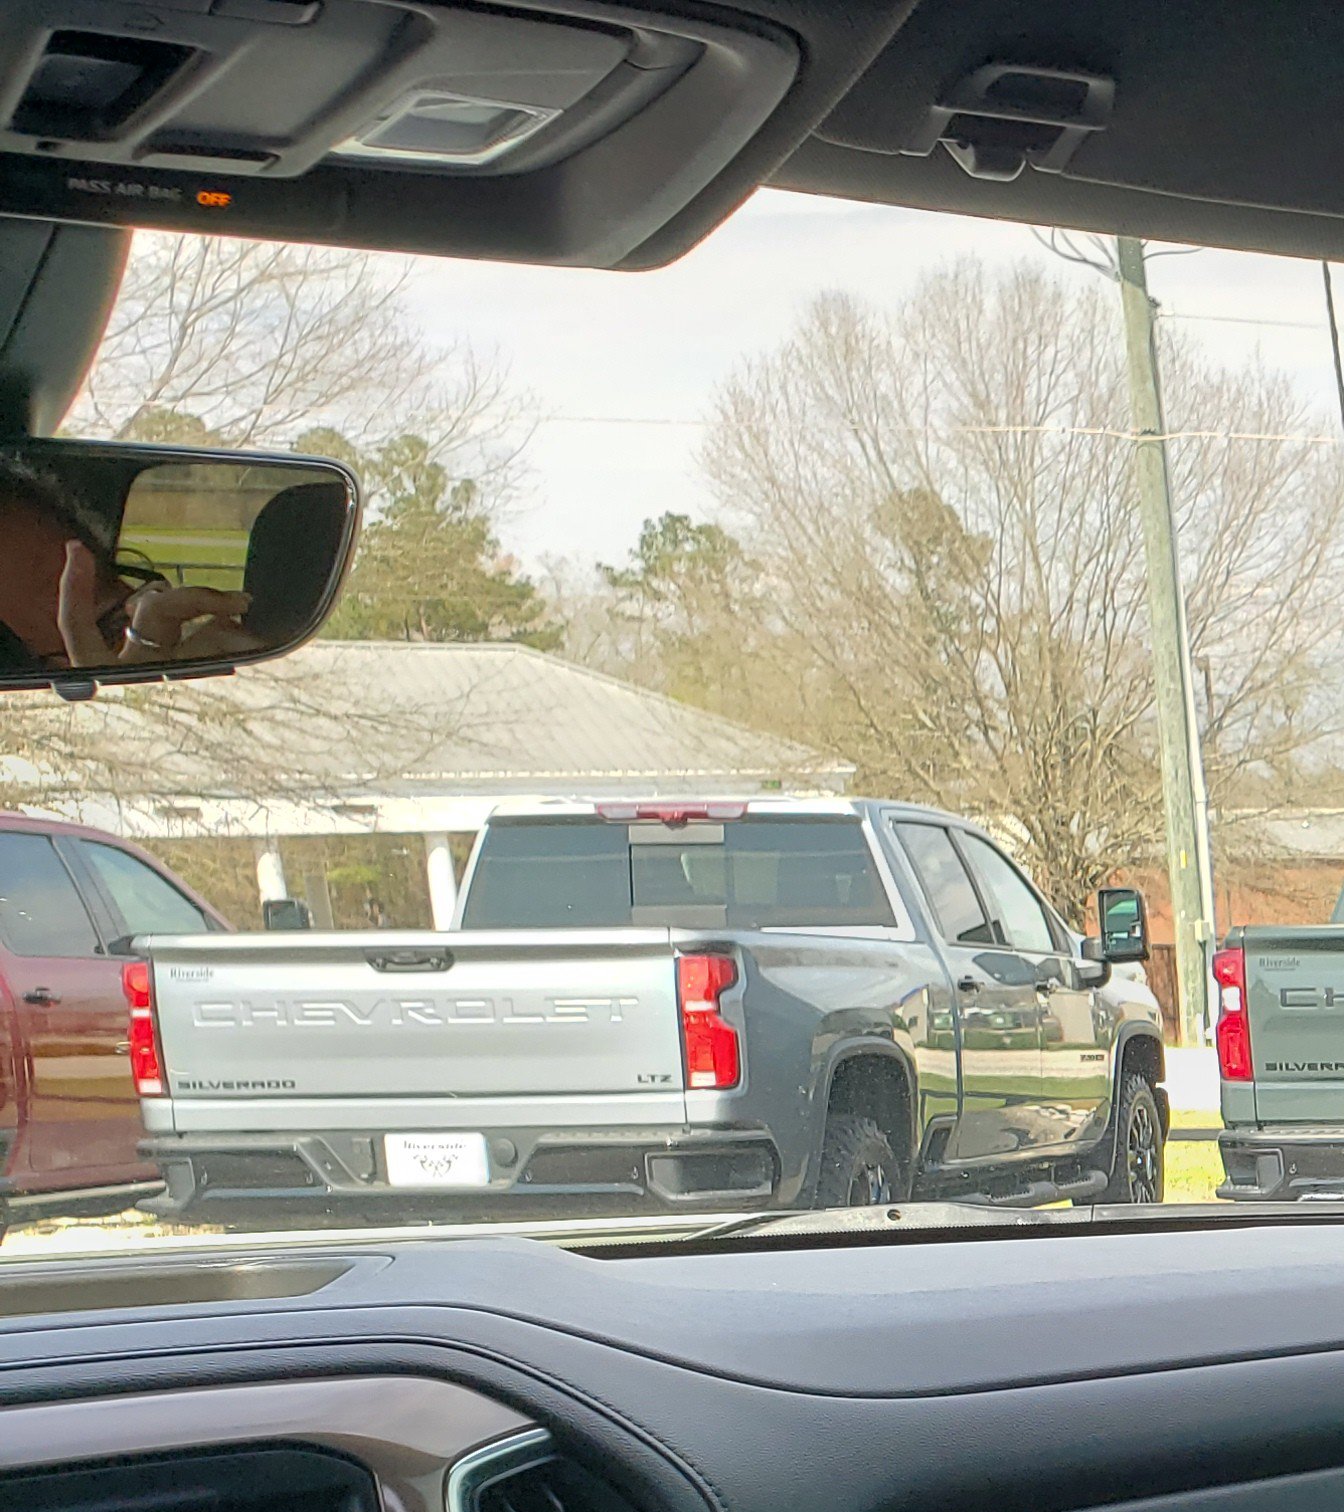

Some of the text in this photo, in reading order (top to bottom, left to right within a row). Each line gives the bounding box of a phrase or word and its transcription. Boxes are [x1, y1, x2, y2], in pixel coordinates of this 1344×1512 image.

[195, 190, 232, 207] OFF
[170, 966, 214, 978] Riverside
[192, 996, 640, 1028] CHEVROLET
[636, 1072, 673, 1084] LTZ
[177, 1079, 297, 1091] SILVERADO
